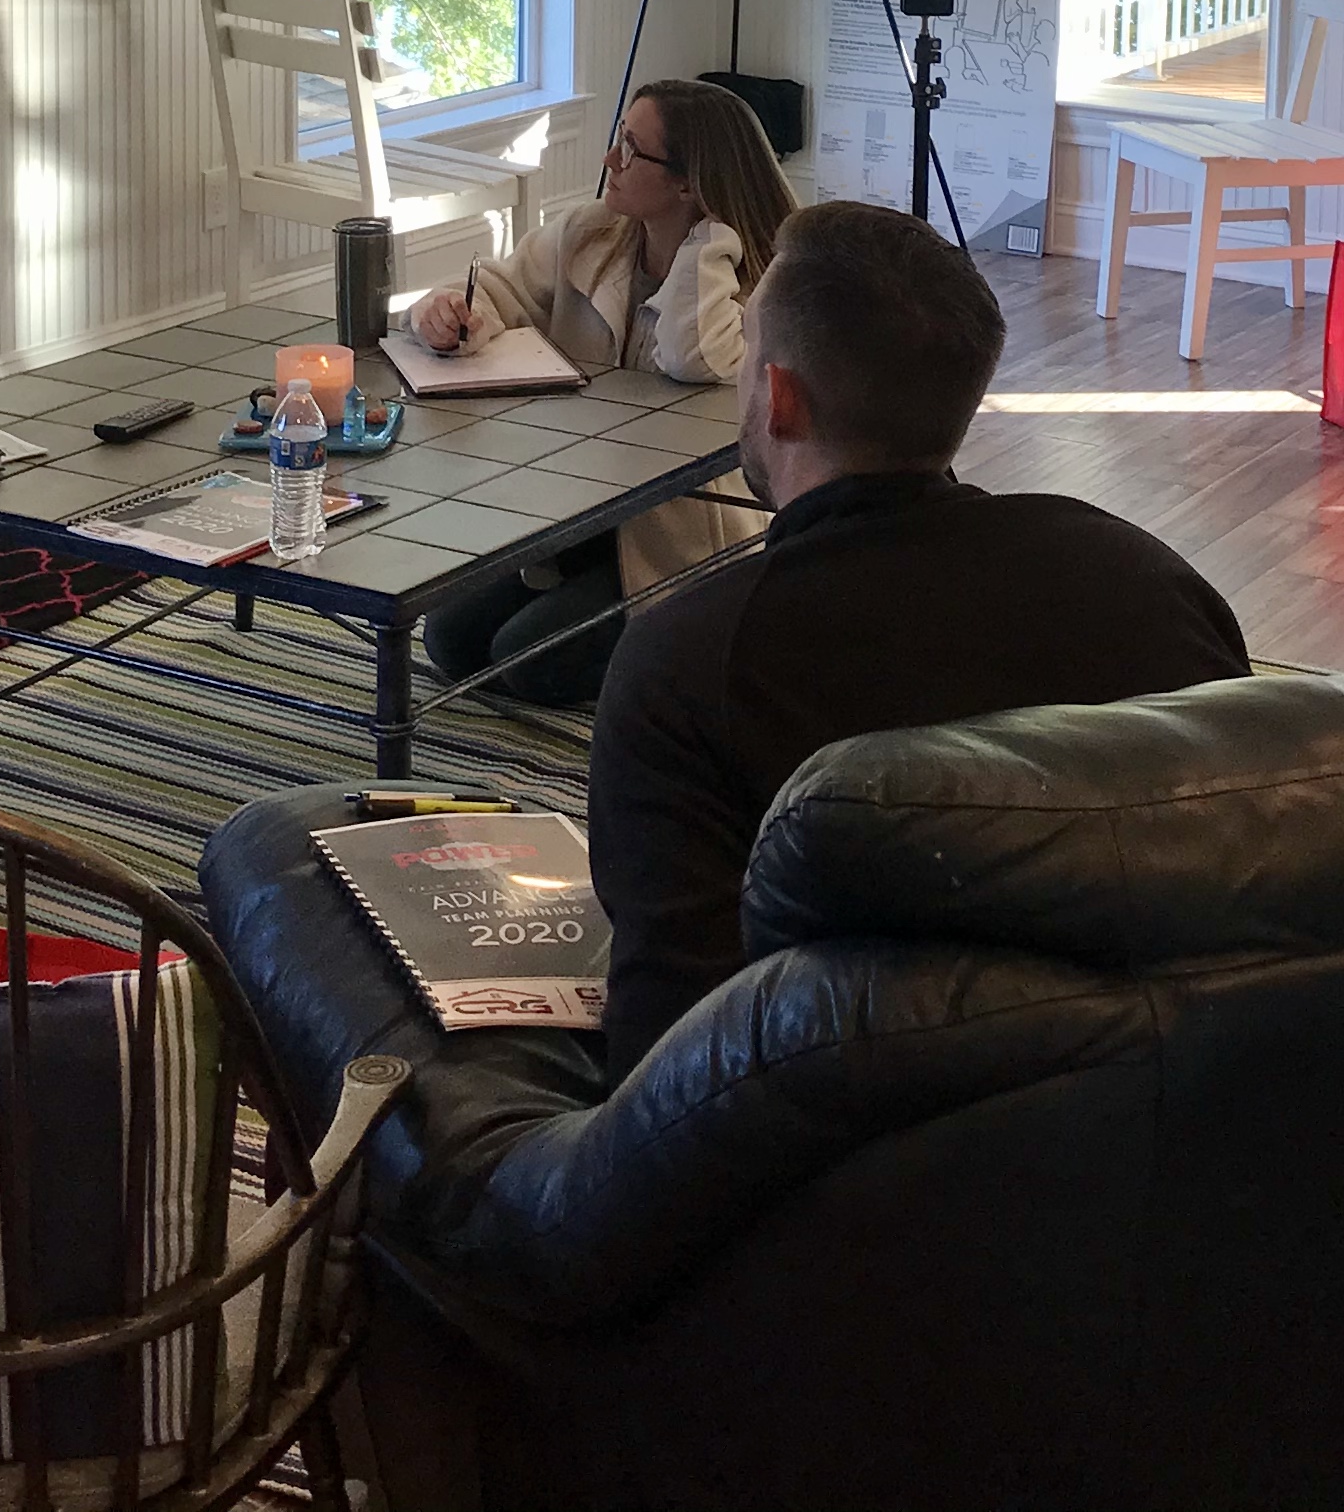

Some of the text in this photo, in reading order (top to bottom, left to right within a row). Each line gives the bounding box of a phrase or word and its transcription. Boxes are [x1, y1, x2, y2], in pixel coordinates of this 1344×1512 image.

[159, 514, 235, 534] 2020
[432, 888, 577, 911] ADVANCE
[441, 904, 585, 924] TEAM PLANNING
[467, 919, 584, 947] 2020
